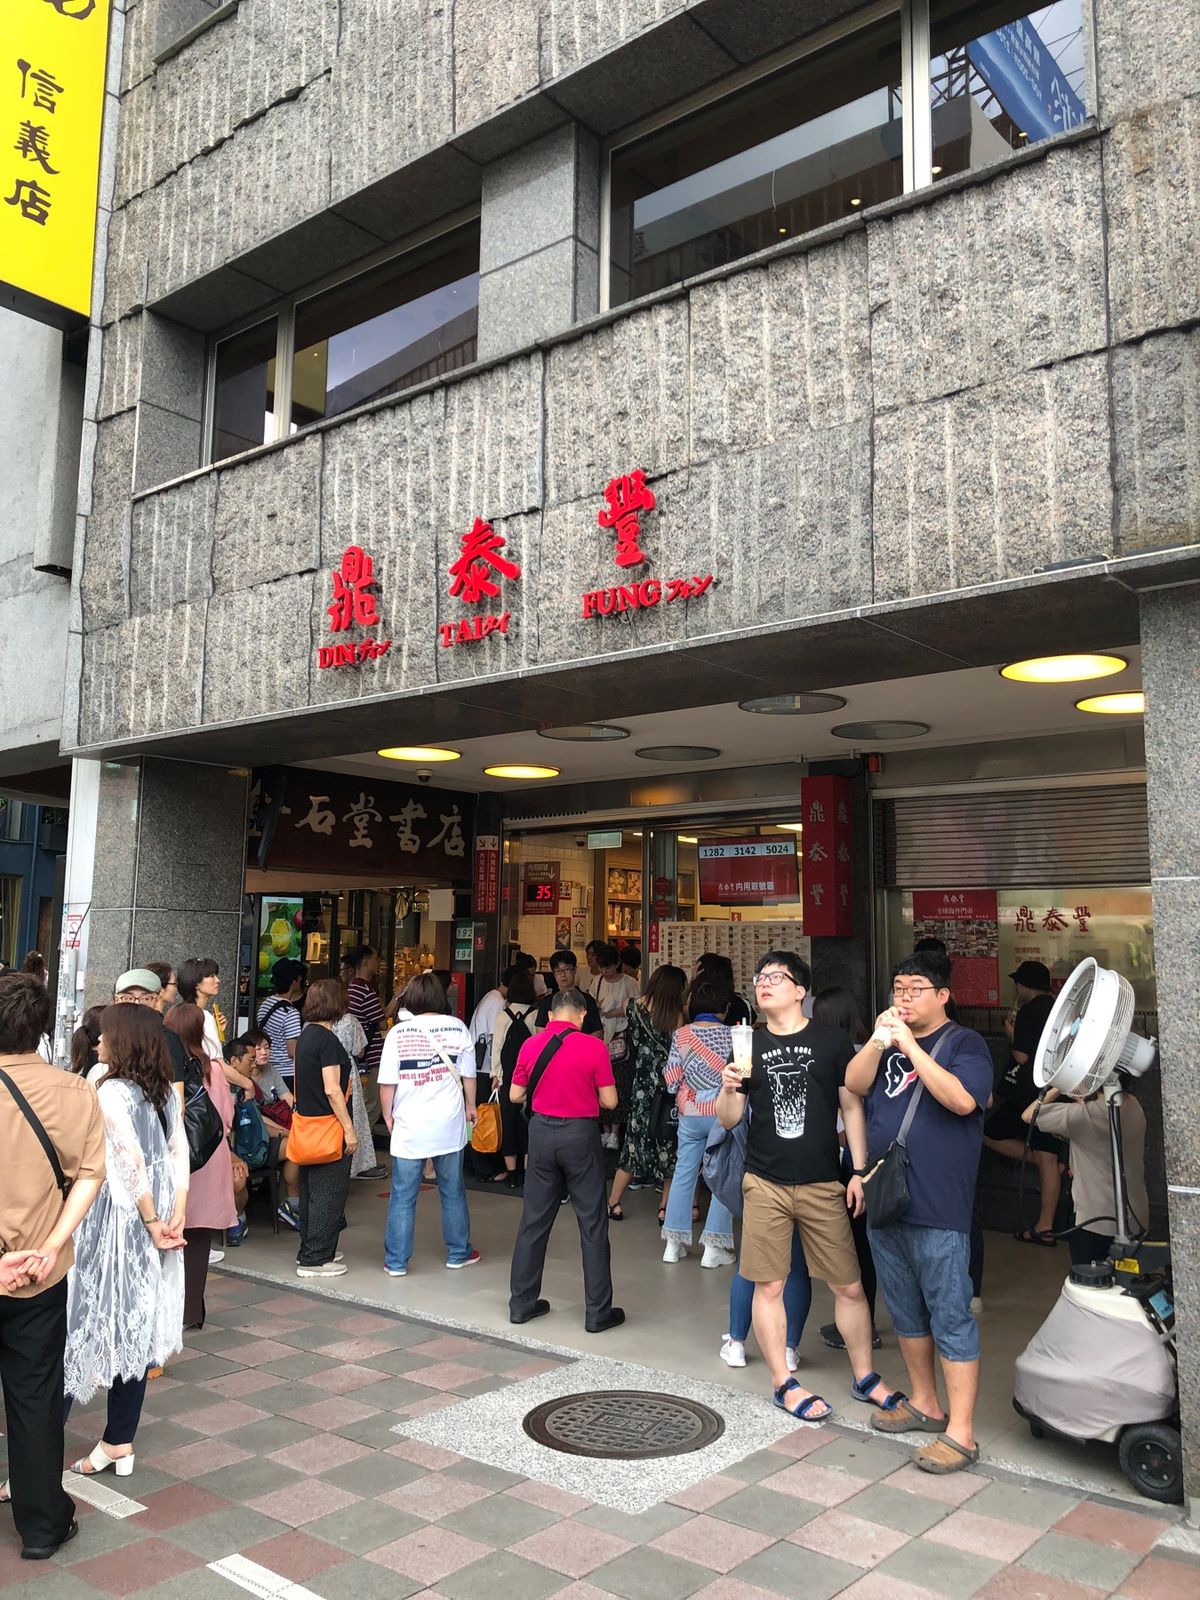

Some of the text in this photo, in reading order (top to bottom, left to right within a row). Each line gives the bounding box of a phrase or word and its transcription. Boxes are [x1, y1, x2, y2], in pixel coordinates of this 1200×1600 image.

[4, 58, 64, 226] 信義店
[582, 580, 661, 618] FUNG
[438, 616, 483, 647] TAI
[319, 643, 355, 669] DIN
[703, 844, 789, 857] 1282 3142 5024
[808, 800, 828, 905] 鼎泰豐
[536, 885, 552, 899] 35
[1013, 905, 1091, 933] 鼎泰豐
[457, 929, 472, 938] 192
[456, 951, 471, 959] 194
